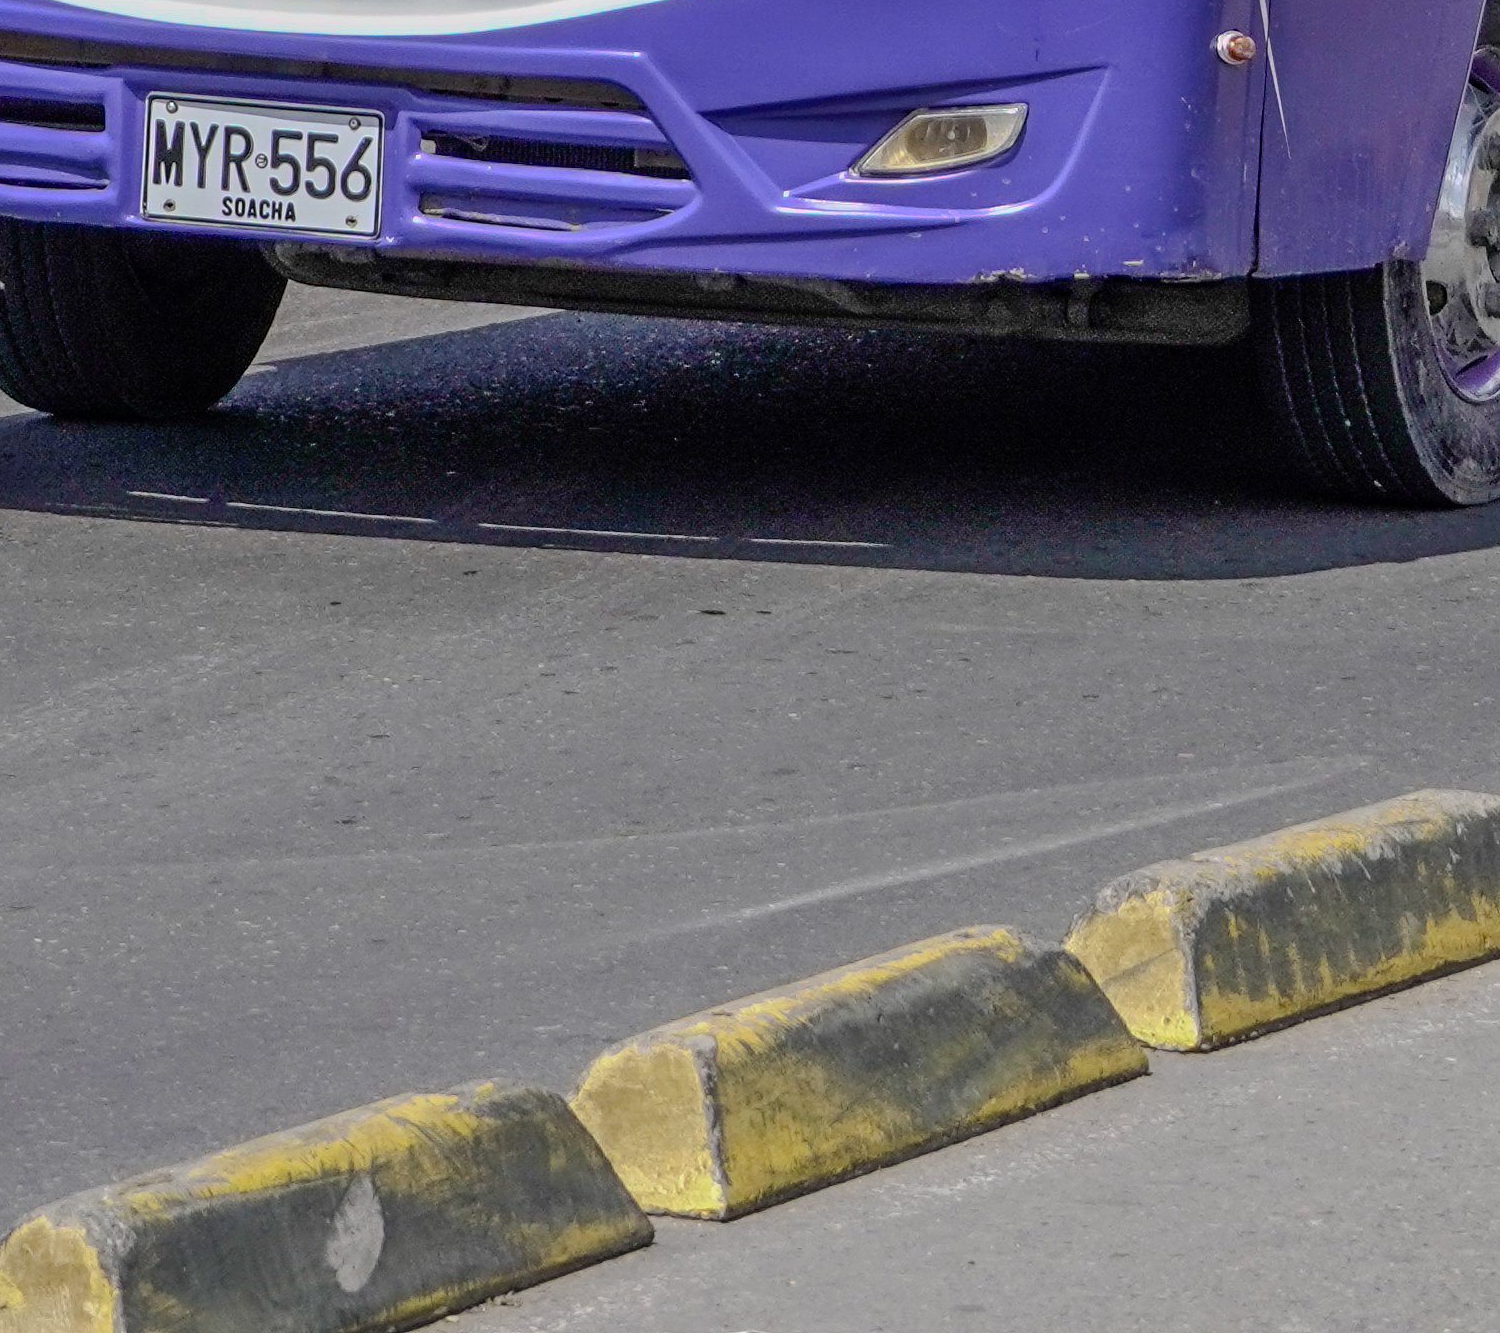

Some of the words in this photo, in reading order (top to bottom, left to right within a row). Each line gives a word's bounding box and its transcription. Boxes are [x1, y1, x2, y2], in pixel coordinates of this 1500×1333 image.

[152, 118, 254, 194] MYR
[269, 128, 374, 202] 556
[221, 195, 296, 222] SOACHA
